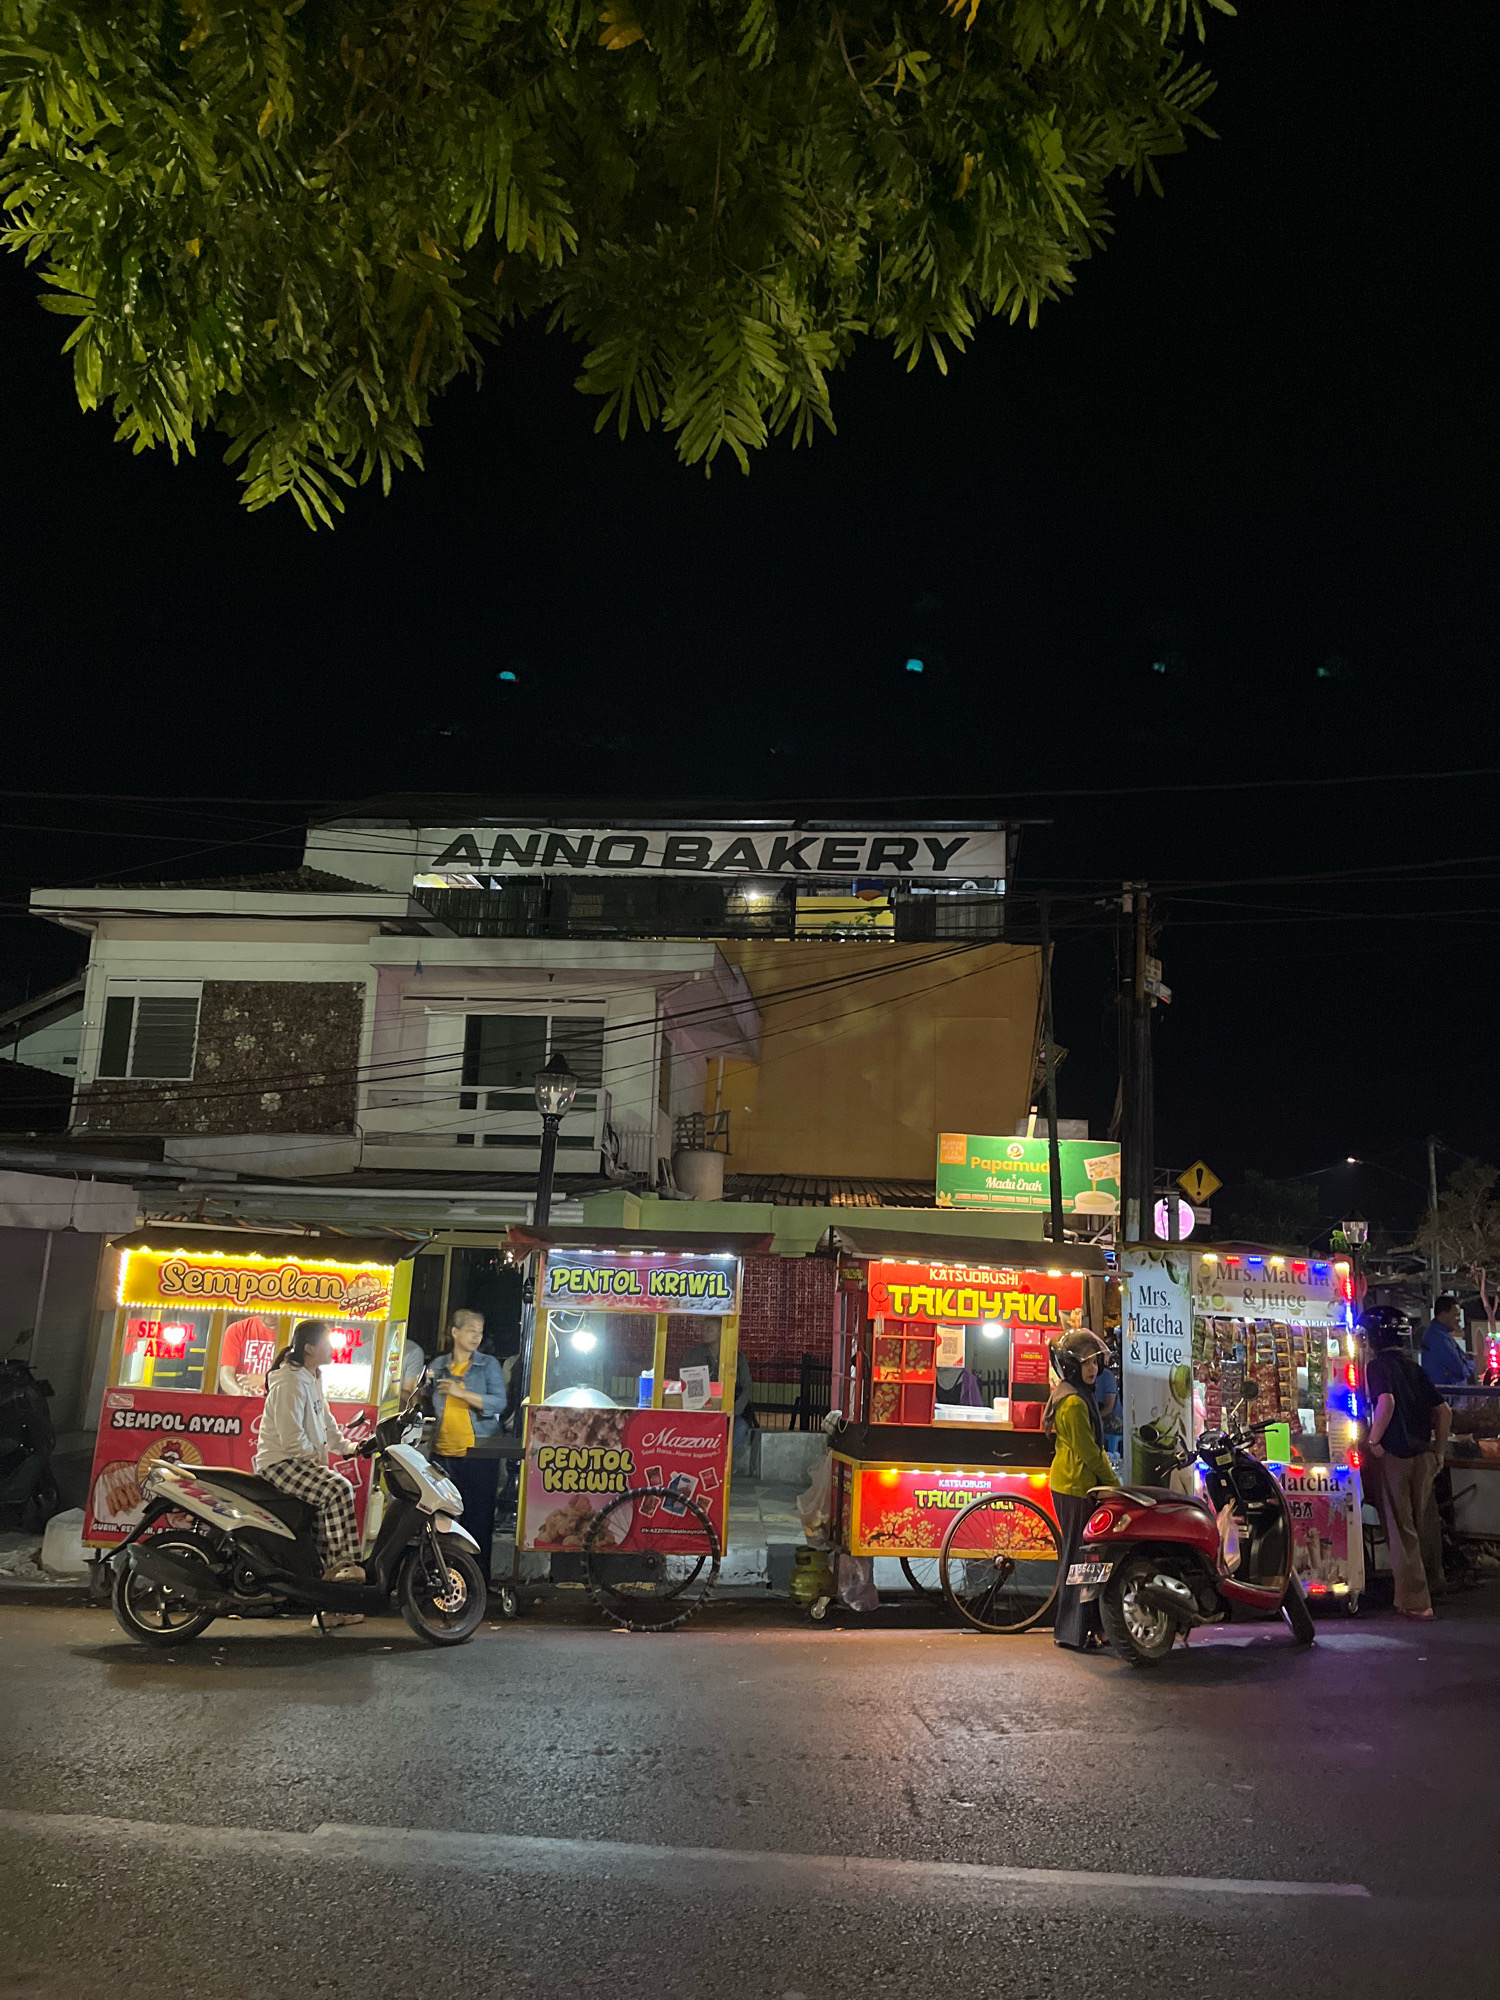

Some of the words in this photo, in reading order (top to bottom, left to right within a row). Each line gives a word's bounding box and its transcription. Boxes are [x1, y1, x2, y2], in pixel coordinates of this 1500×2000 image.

[432, 834, 649, 868] ANNO
[660, 836, 971, 872] BAKERY
[970, 1156, 1051, 1174] Papamud
[985, 1176, 1016, 1190] Madu
[1016, 1178, 1043, 1192] Enak
[162, 1262, 344, 1303] Sempolan
[551, 1267, 642, 1295] PENTOL
[929, 1267, 1020, 1286] KATSUOBUSHI
[1216, 1262, 1257, 1282] Mrs.
[1262, 1264, 1330, 1287] Matcha
[887, 1284, 1058, 1323] TAKOYAKI
[1139, 1285, 1171, 1307] Mrs.
[1243, 1287, 1257, 1305] &
[1260, 1287, 1307, 1310] Juice
[1128, 1312, 1184, 1336] Matcha
[1130, 1341, 1141, 1361] &
[1144, 1340, 1183, 1366] Juice
[113, 1411, 185, 1431] SEMPOL
[190, 1417, 240, 1434] AYAM
[641, 1427, 722, 1450] Mazzoni
[539, 1448, 634, 1472] PENTOL
